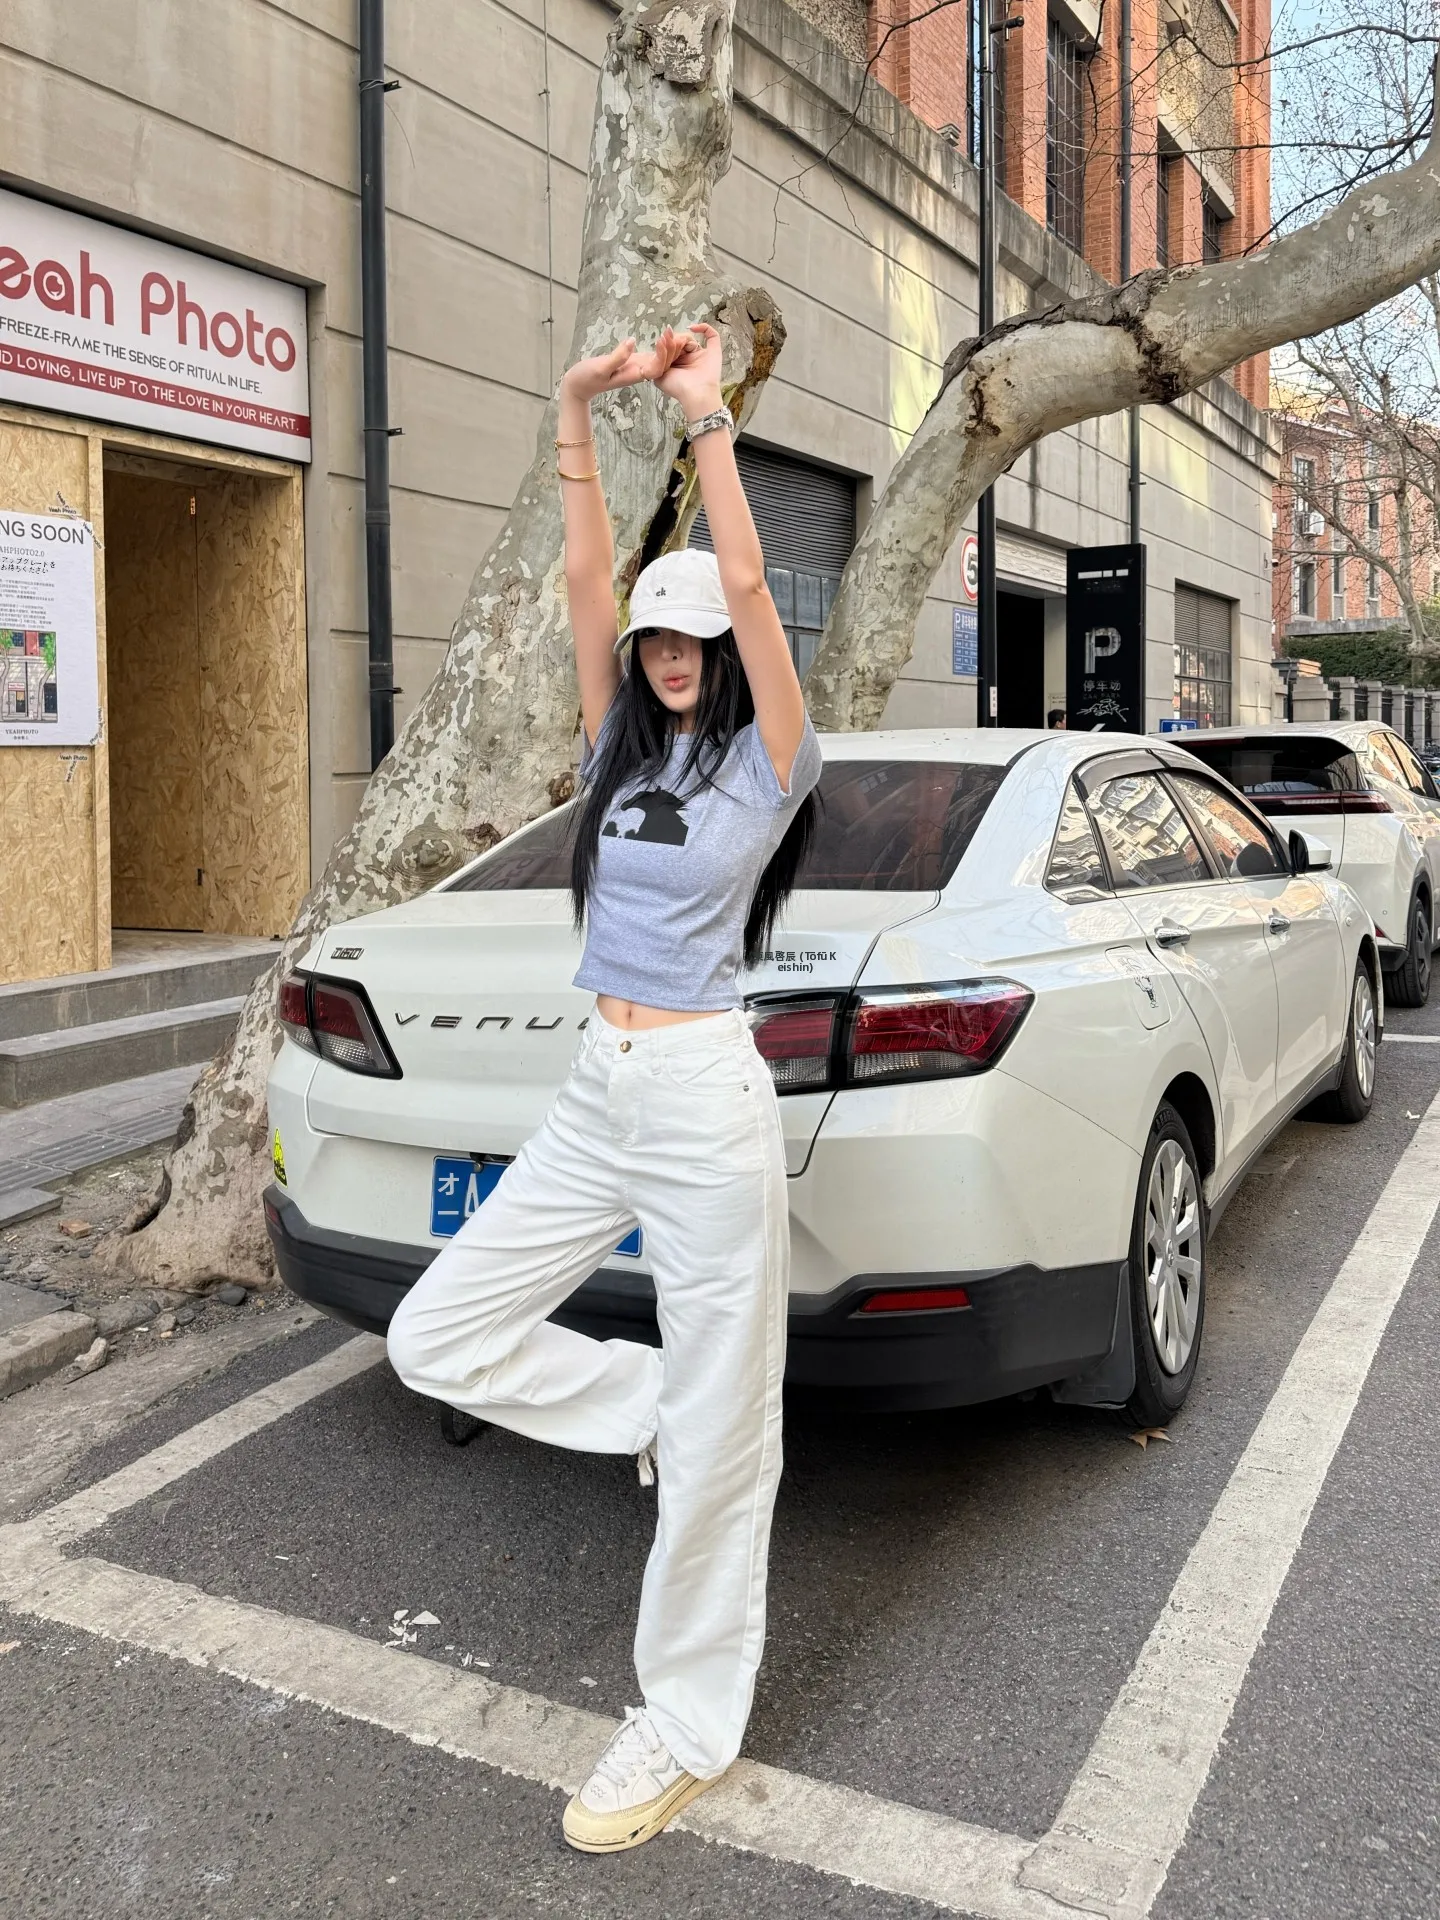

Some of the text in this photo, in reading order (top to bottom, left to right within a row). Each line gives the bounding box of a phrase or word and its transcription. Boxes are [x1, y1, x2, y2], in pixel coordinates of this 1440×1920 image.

[141, 271, 296, 373] Photo
[0, 316, 263, 394] FREEZE-FRAME THE SENSE OF RITUAL IN LIFE.
[0, 350, 299, 432] D LOVING, LIVE UP TO THE LOVE IN YOUR HEART.
[31, 523, 84, 545] SOON
[1084, 627, 1122, 674] P
[394, 1011, 588, 1031] VENU
